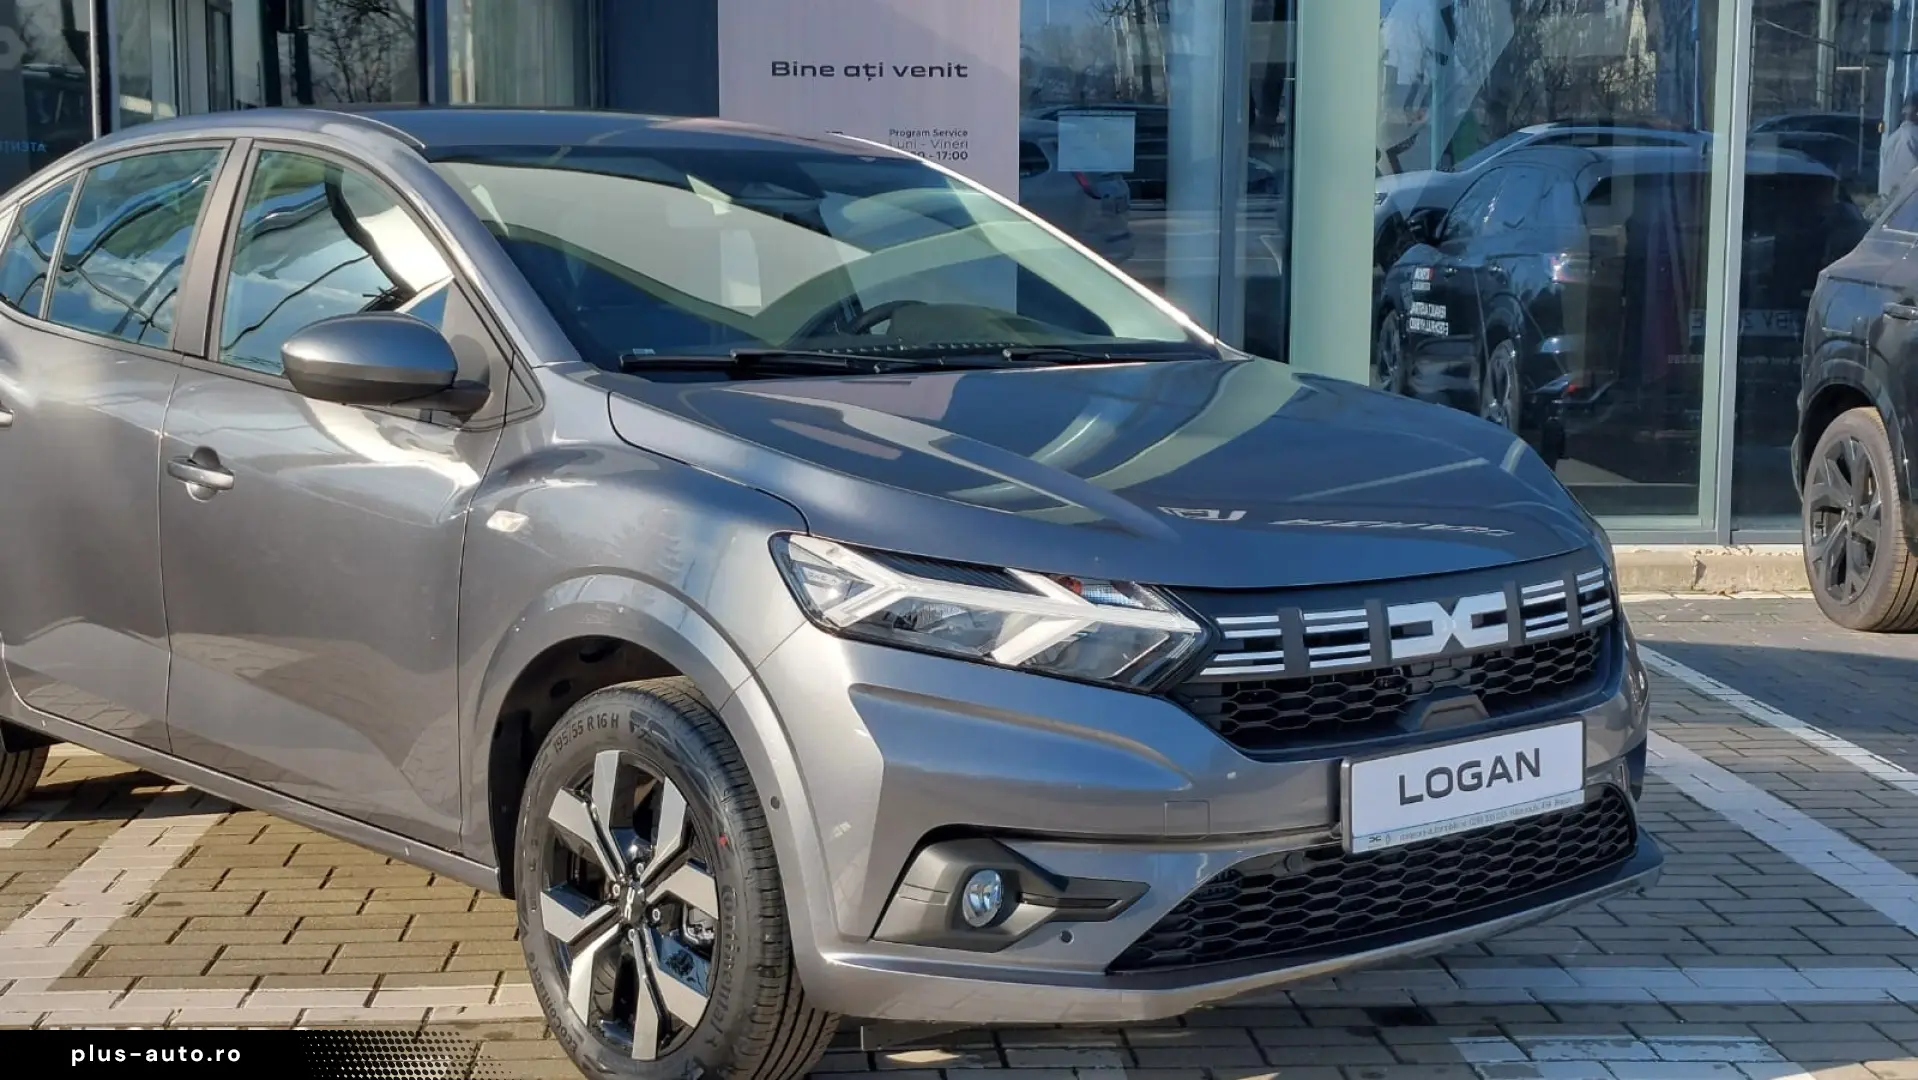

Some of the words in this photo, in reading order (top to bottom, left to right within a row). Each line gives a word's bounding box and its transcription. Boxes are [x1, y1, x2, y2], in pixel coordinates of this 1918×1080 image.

[771, 61, 835, 78] Bine
[843, 62, 884, 82] ați
[892, 62, 968, 78] venit
[888, 128, 930, 139] Program
[932, 128, 968, 138] Service
[930, 139, 968, 150] Vineri
[936, 151, 968, 161] 17:00
[587, 715, 594, 731] R
[597, 714, 607, 729] 16
[611, 713, 619, 728] H
[1398, 747, 1541, 806] LOGAN
